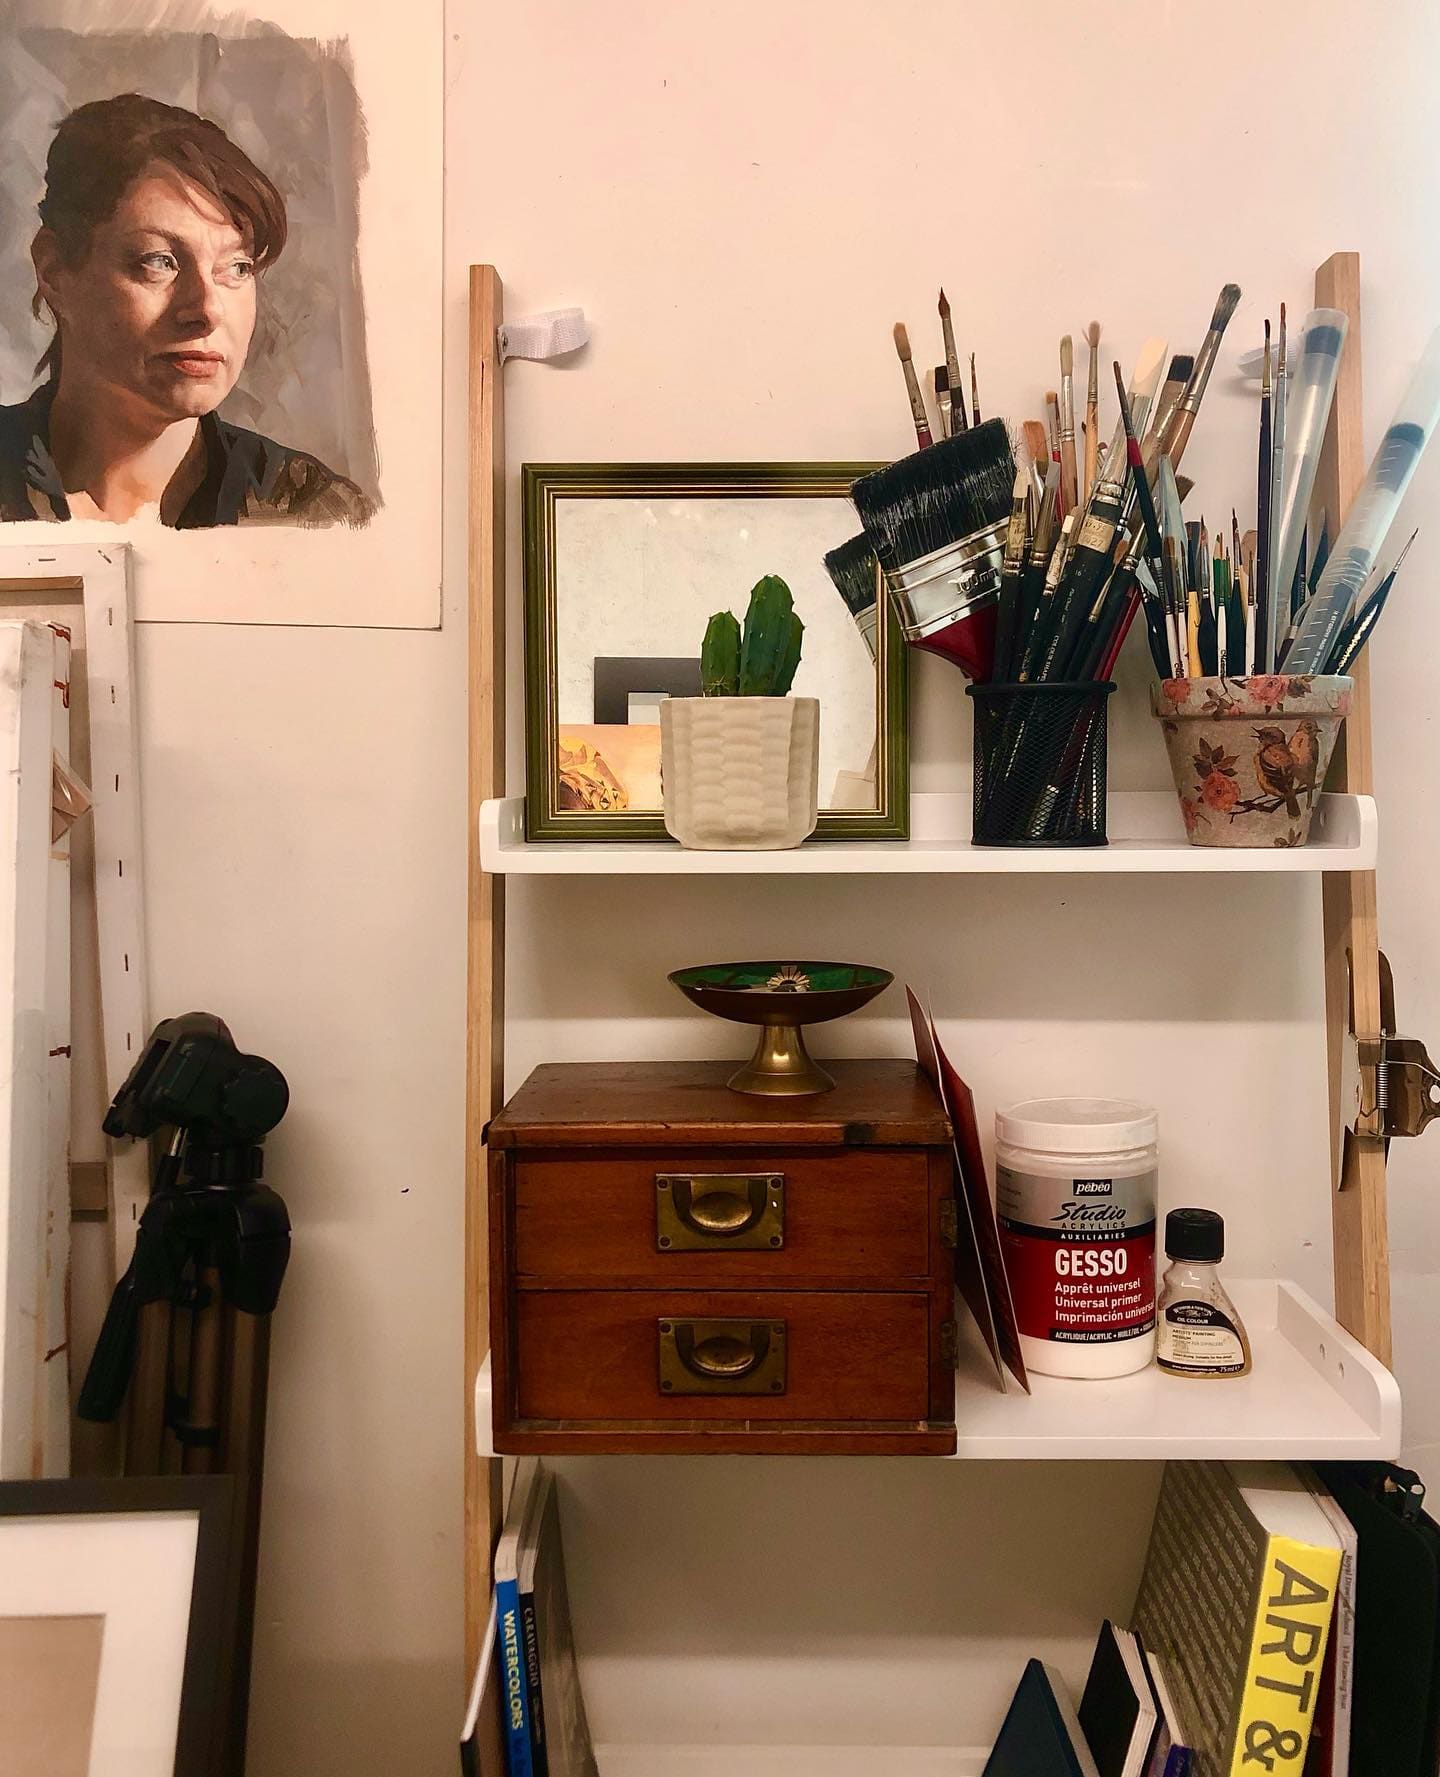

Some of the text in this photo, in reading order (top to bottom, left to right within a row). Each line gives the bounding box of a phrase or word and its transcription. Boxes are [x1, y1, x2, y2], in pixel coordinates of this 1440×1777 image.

[1049, 1201, 1127, 1221] Studio
[1061, 1221, 1126, 1230] ACRYLICS
[1060, 1231, 1126, 1241] AUXILIARIES
[1055, 1248, 1128, 1277] GESSO
[1055, 1277, 1141, 1296] Apprêt universel
[1055, 1293, 1142, 1310] Universal primer
[1055, 1309, 1124, 1325] Imprimación
[1186, 1317, 1209, 1325] COLOUR
[504, 1609, 524, 1731] WATERCOLORS
[1242, 1558, 1329, 1774] ART &
